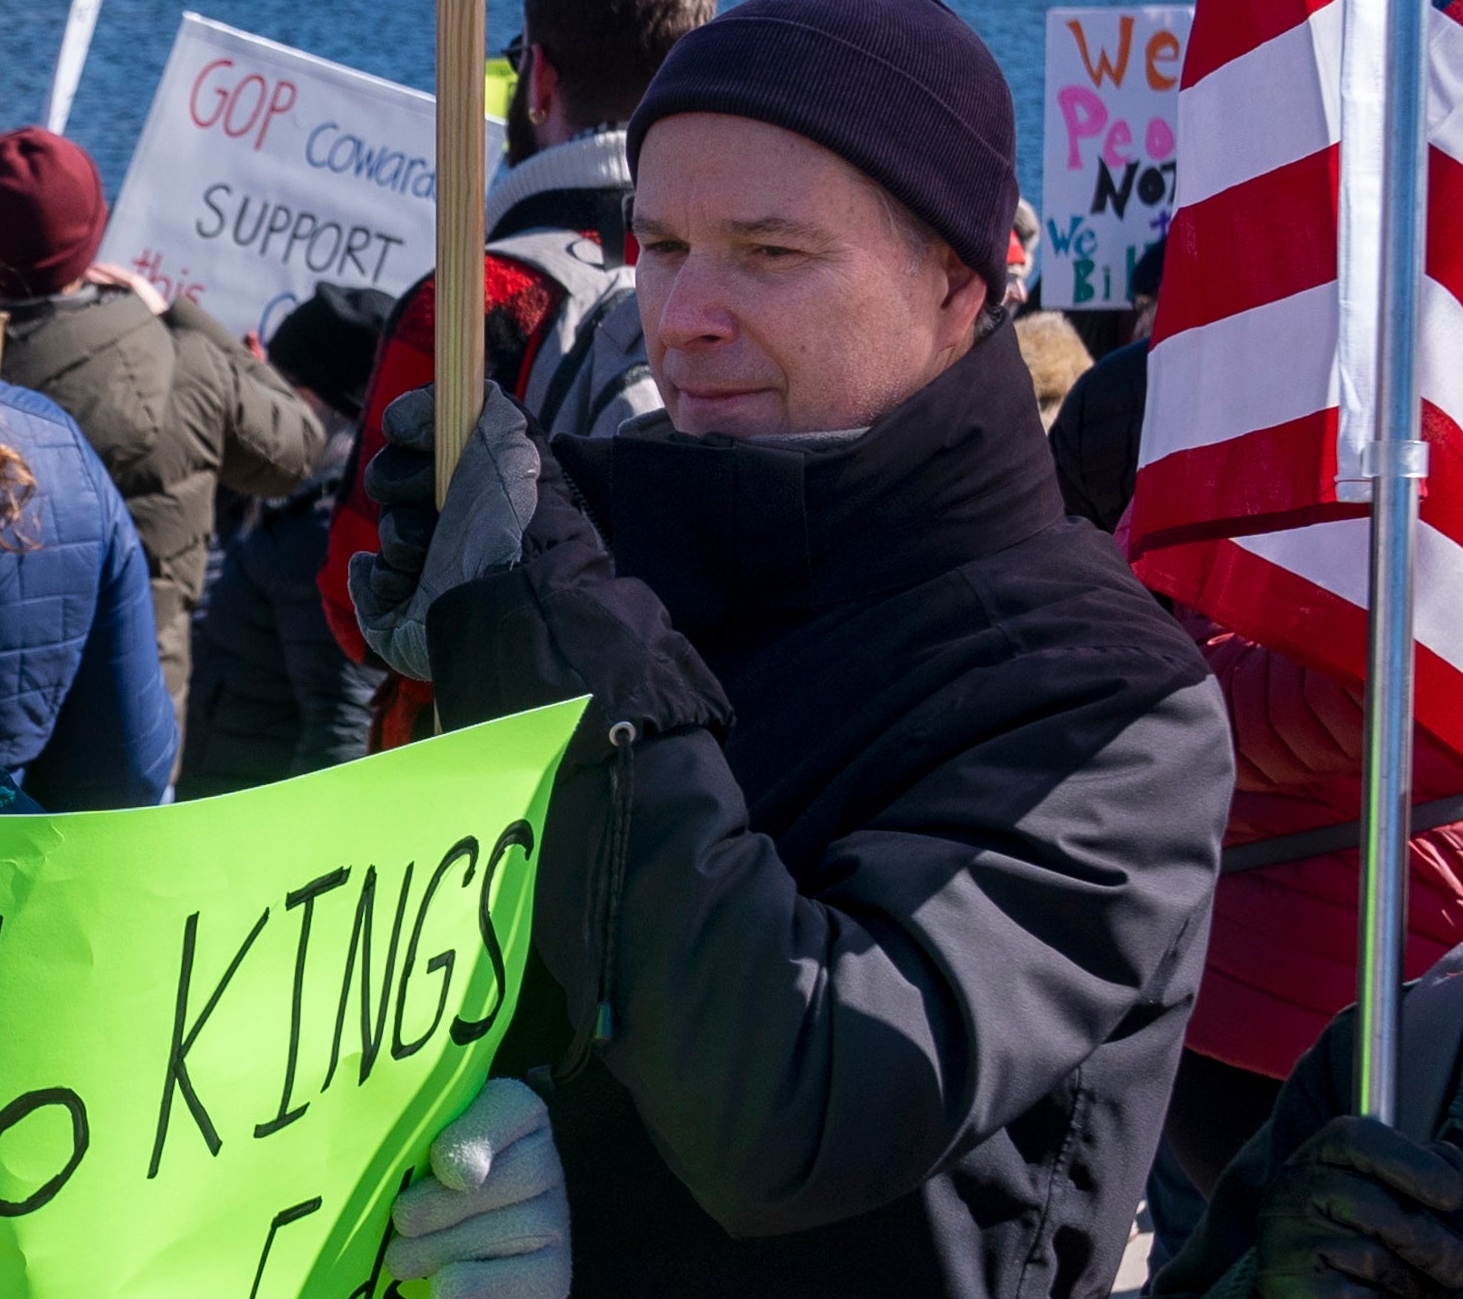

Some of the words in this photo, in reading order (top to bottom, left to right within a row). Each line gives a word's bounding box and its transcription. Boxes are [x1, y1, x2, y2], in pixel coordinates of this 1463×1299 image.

[1065, 15, 1180, 92] We
[189, 57, 298, 152] GOP
[1056, 84, 1176, 171] Peo
[196, 182, 405, 285] SUPPORT
[1047, 215, 1097, 257] We
[148, 818, 536, 1180] KINGS
